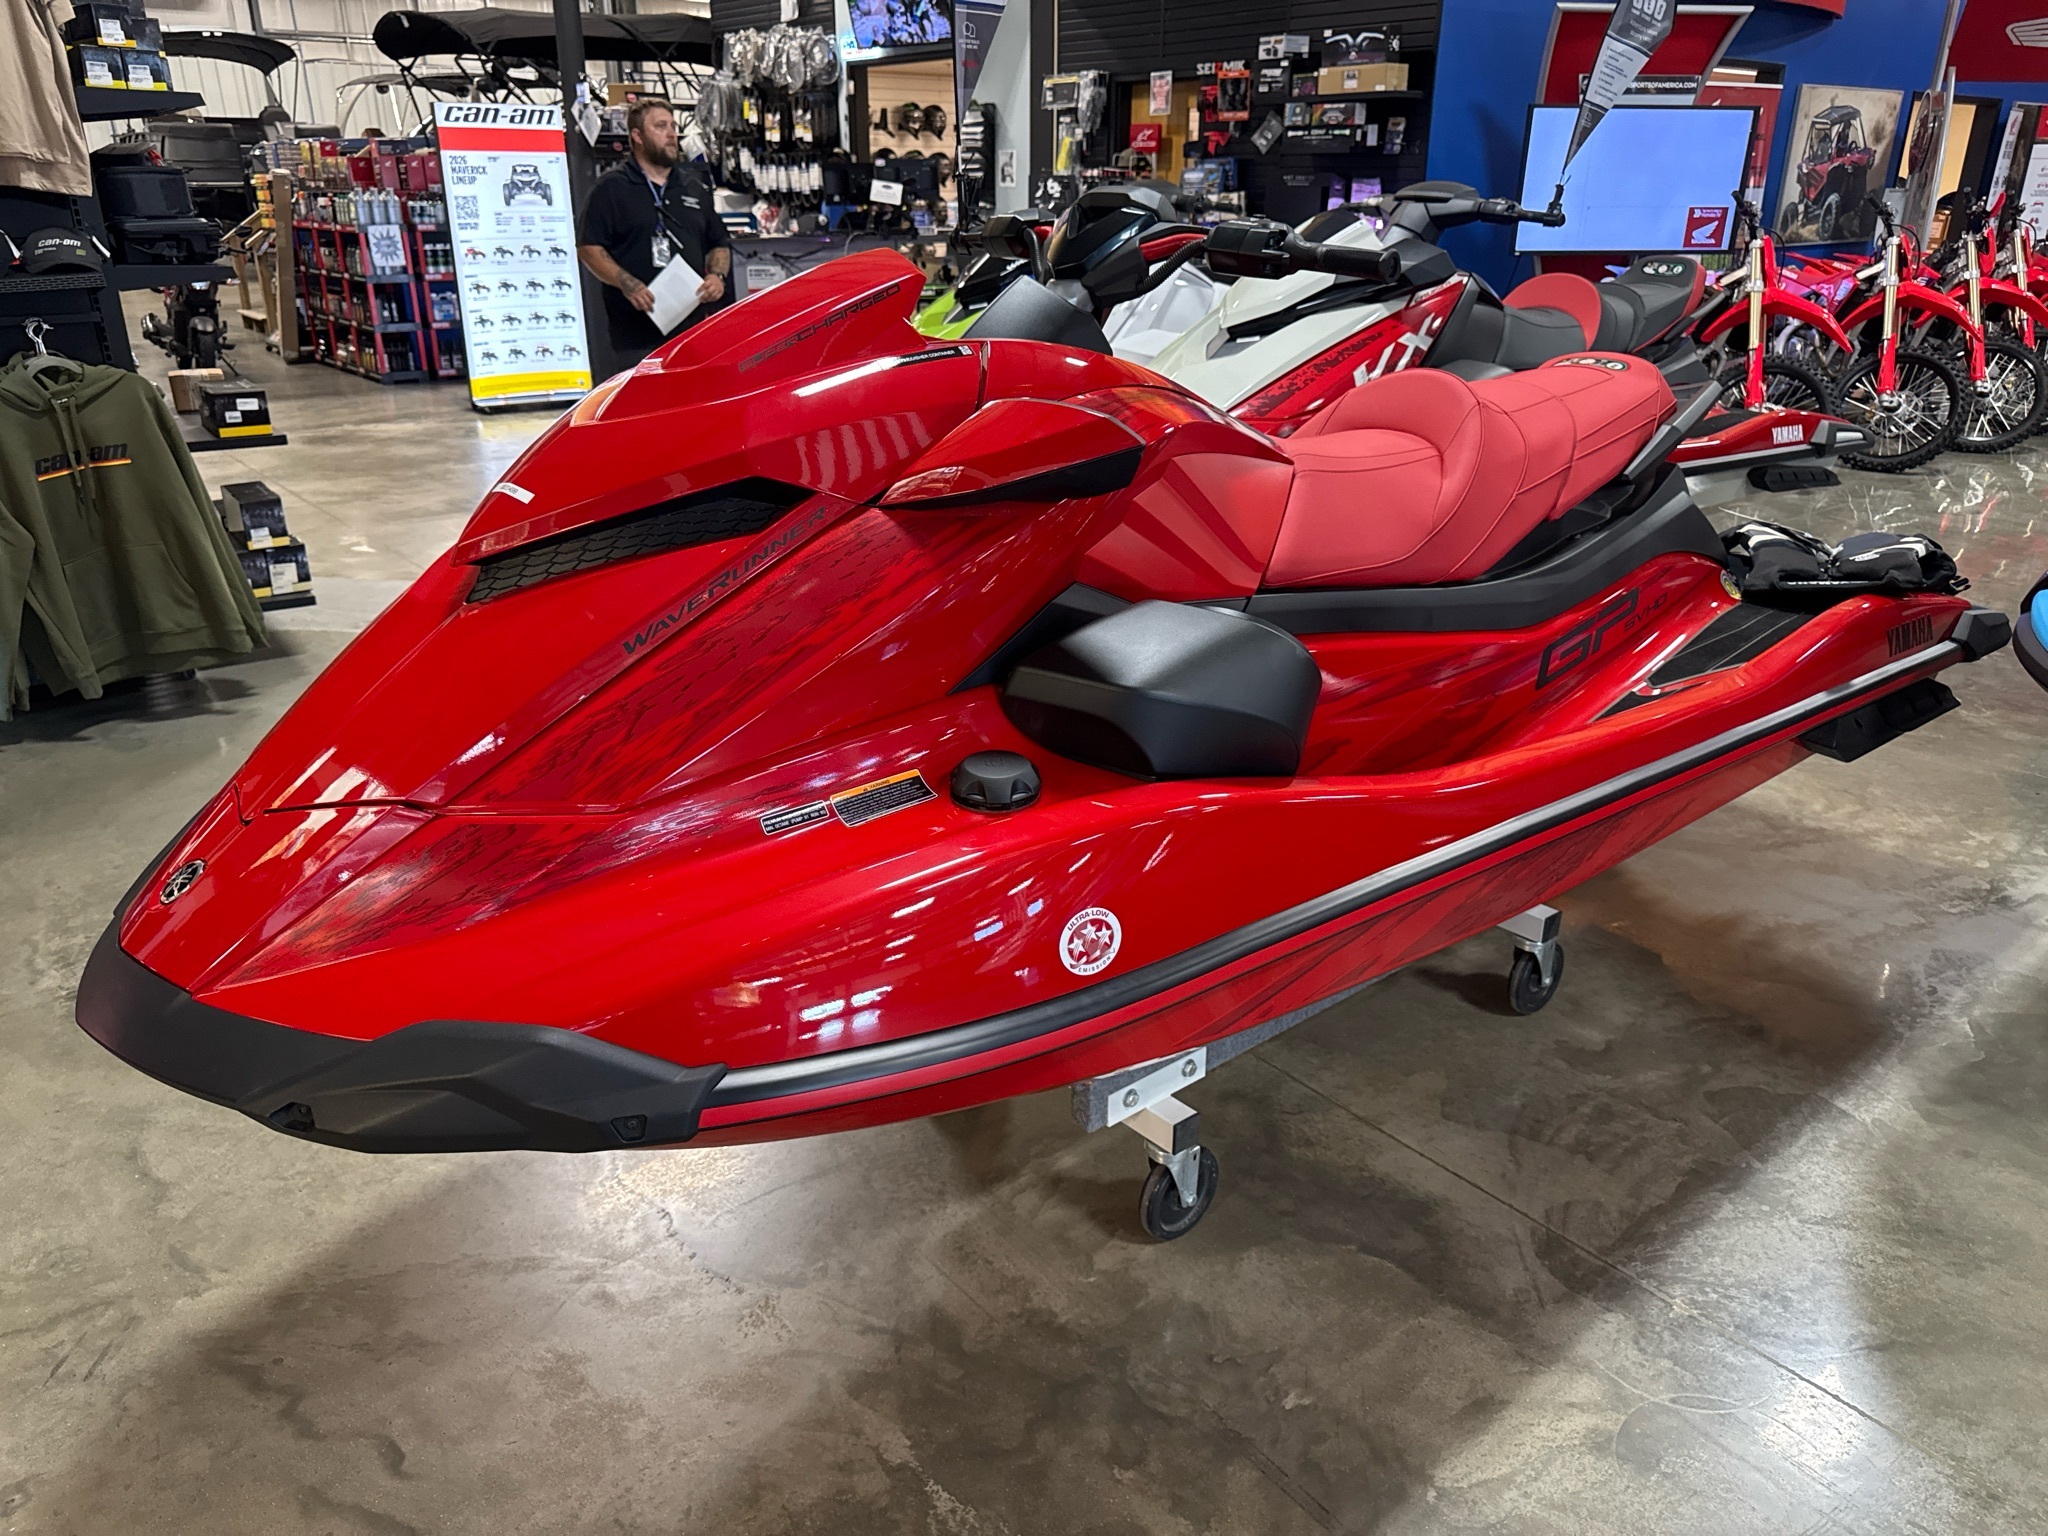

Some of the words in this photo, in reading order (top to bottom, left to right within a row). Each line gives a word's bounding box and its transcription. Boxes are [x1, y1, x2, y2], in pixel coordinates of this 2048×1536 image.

[1196, 60, 1245, 75] SEIZMIK
[444, 106, 554, 125] can-am
[451, 166, 488, 175] MAVERICK
[452, 176, 477, 185] LINEUP
[739, 282, 901, 373] SUPERCHARGED
[1771, 424, 1804, 445] YAMAHA
[622, 506, 825, 654] WAVERUNNER
[1624, 592, 1668, 632] SVHO
[1535, 586, 1640, 690] GP
[1886, 613, 1934, 658] YAMAHA
[1067, 911, 1090, 931] ULTRA
[1091, 909, 1110, 919] LOW
[1078, 955, 1112, 973] EMISSION
